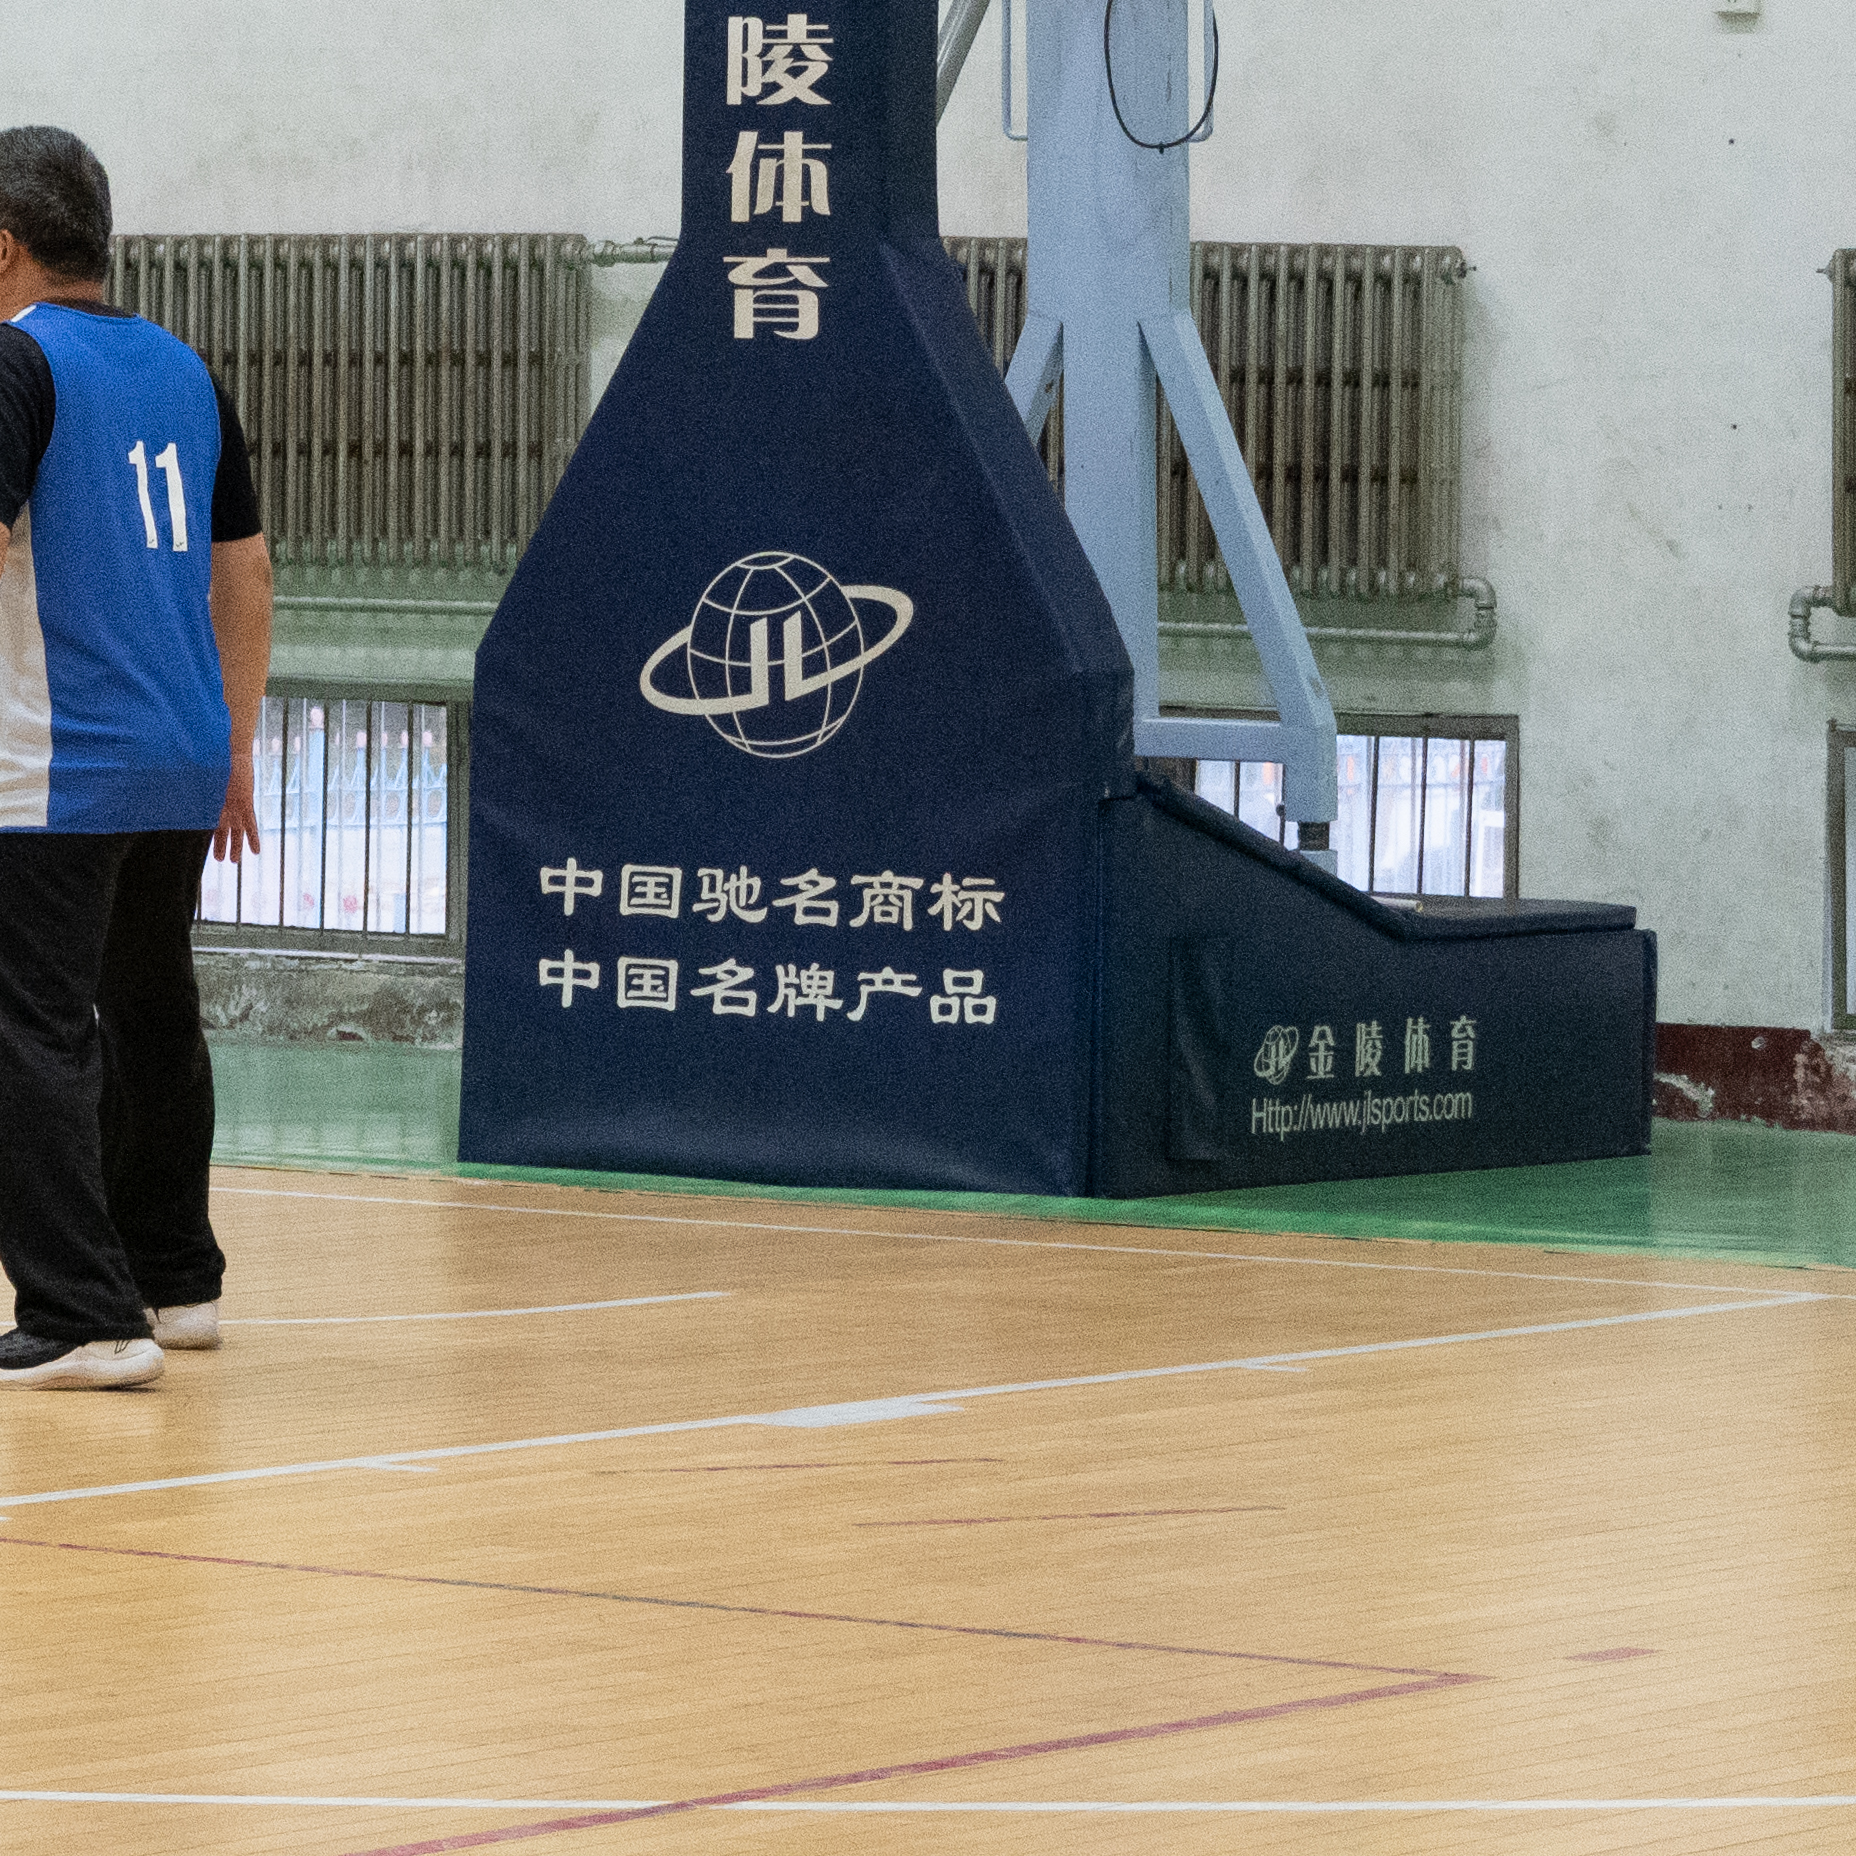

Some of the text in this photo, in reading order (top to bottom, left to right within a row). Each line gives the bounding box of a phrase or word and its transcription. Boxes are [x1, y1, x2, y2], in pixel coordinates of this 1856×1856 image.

[128, 440, 188, 552] 11
[539, 857, 1006, 932] 中国驰名商标
[538, 949, 997, 1025] 中国名牌产品
[1305, 1014, 1478, 1080] 金陵体育
[1251, 1089, 1473, 1141] Http://www.jlsports.com
